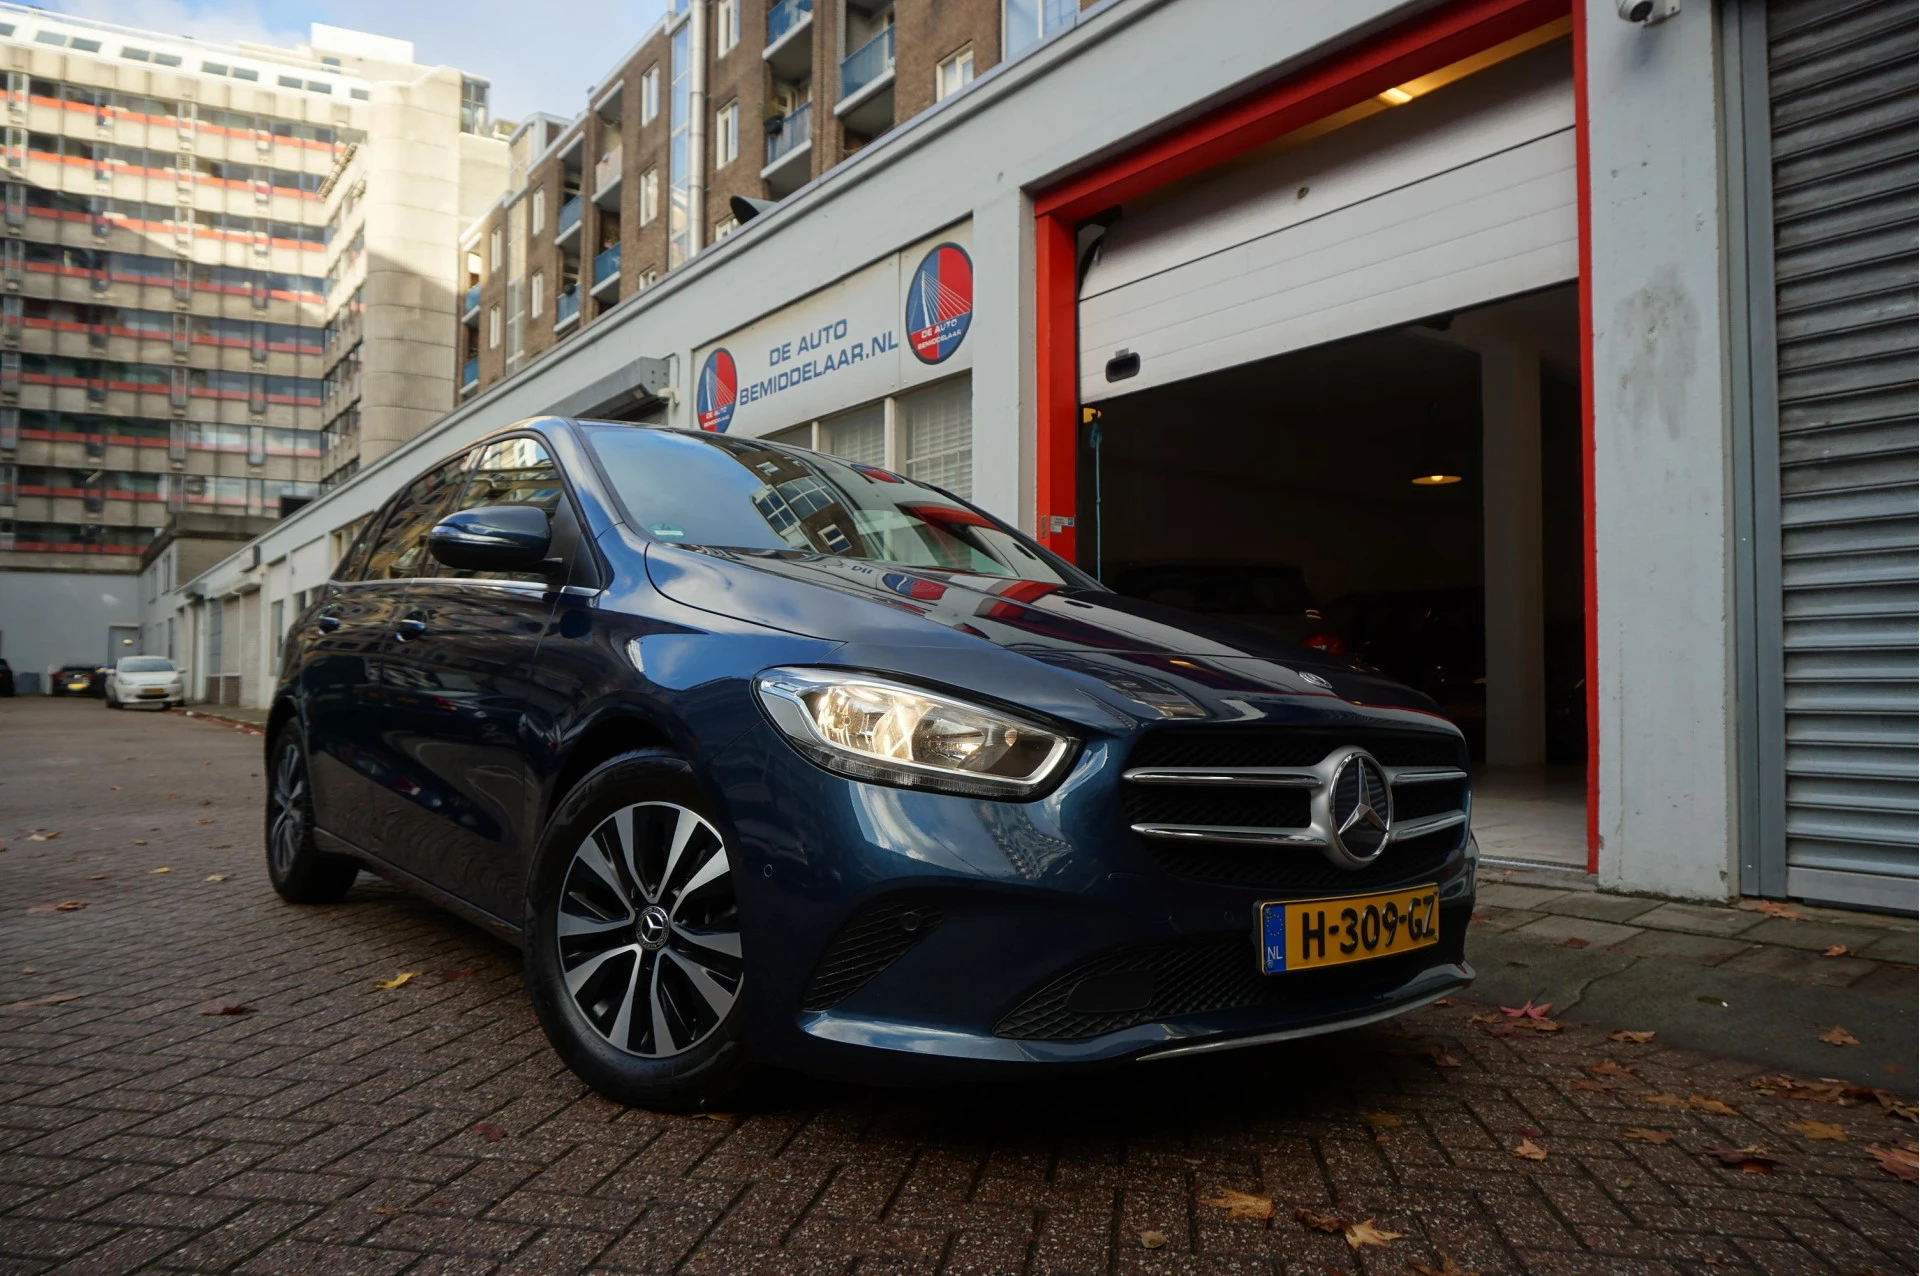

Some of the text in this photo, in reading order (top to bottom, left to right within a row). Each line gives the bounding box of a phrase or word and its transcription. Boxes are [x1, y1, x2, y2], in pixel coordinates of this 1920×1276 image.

[769, 318, 848, 367] DE AUTO
[921, 318, 958, 339] DE AUTO
[739, 330, 899, 406] BEMIDDELAAR.NL
[1302, 894, 1436, 960] H-309-GZ
[1267, 945, 1283, 961] NL
